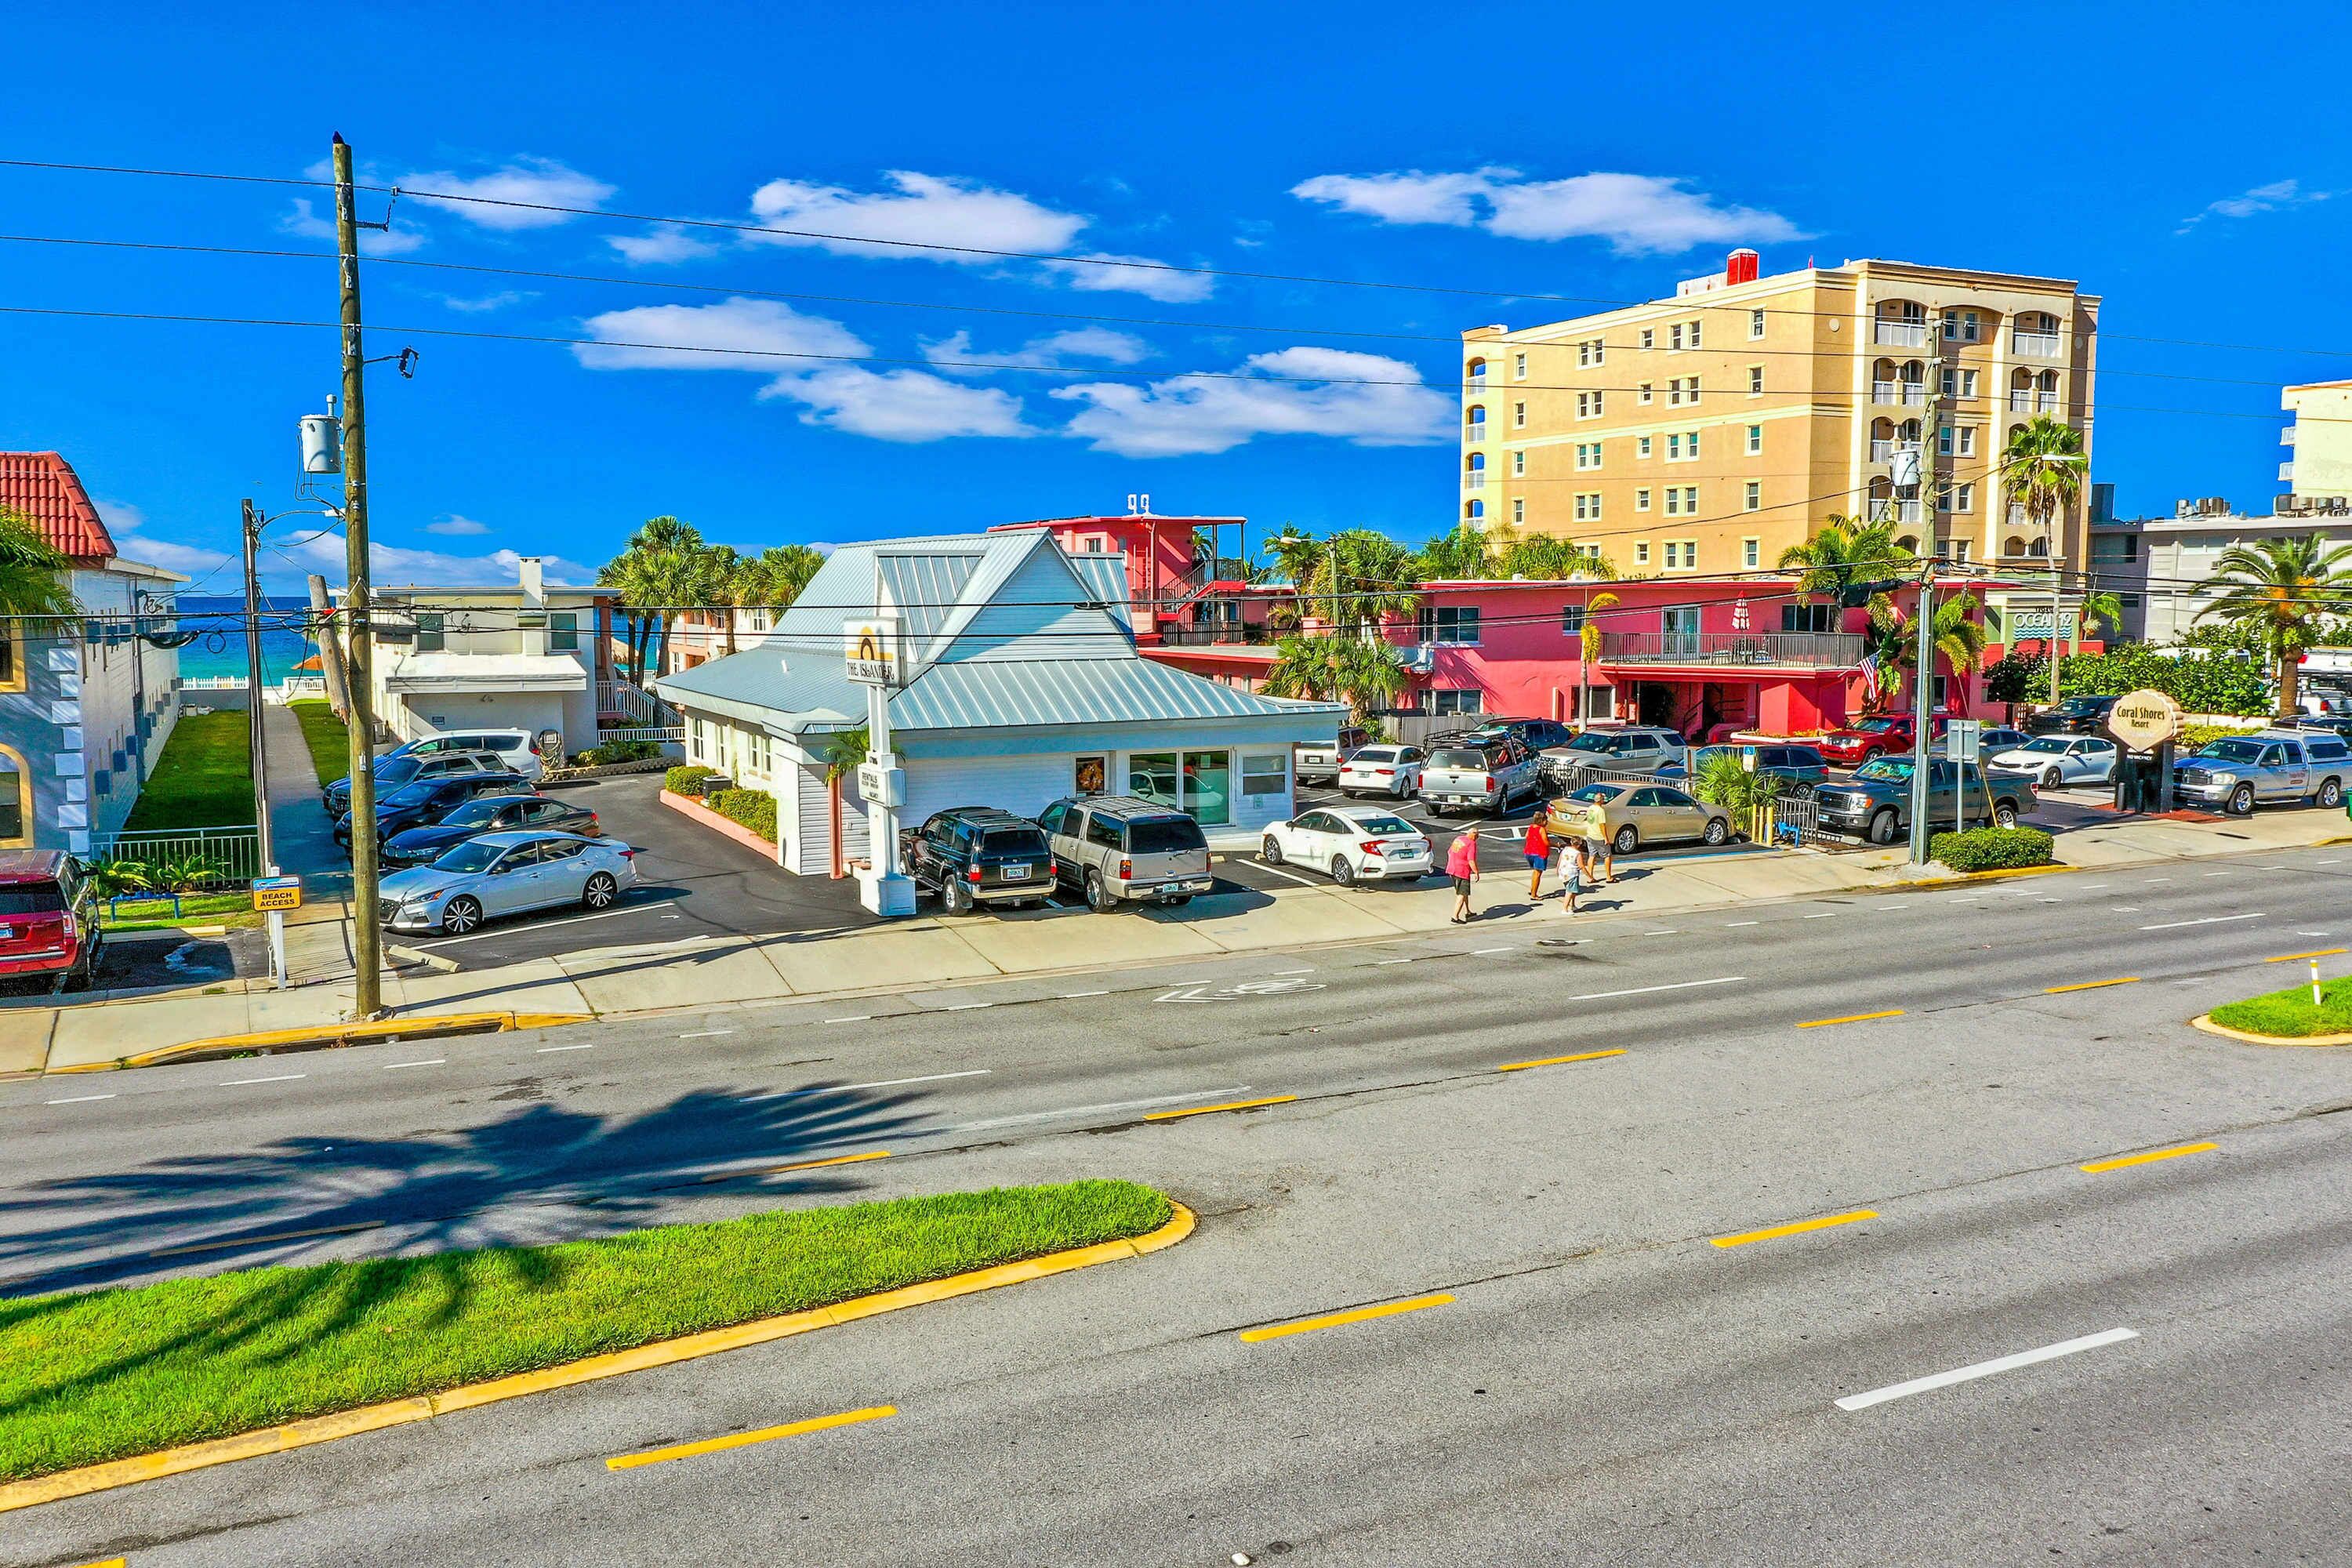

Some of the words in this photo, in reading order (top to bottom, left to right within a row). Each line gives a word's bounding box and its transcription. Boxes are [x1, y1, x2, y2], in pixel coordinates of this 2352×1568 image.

[2059, 612, 2072, 627] 12
[847, 662, 858, 676] THE
[860, 663, 895, 680] ISLANDER
[2117, 706, 2138, 718] Coral
[2140, 707, 2165, 720] Shores
[260, 898, 295, 907] ACCESS
